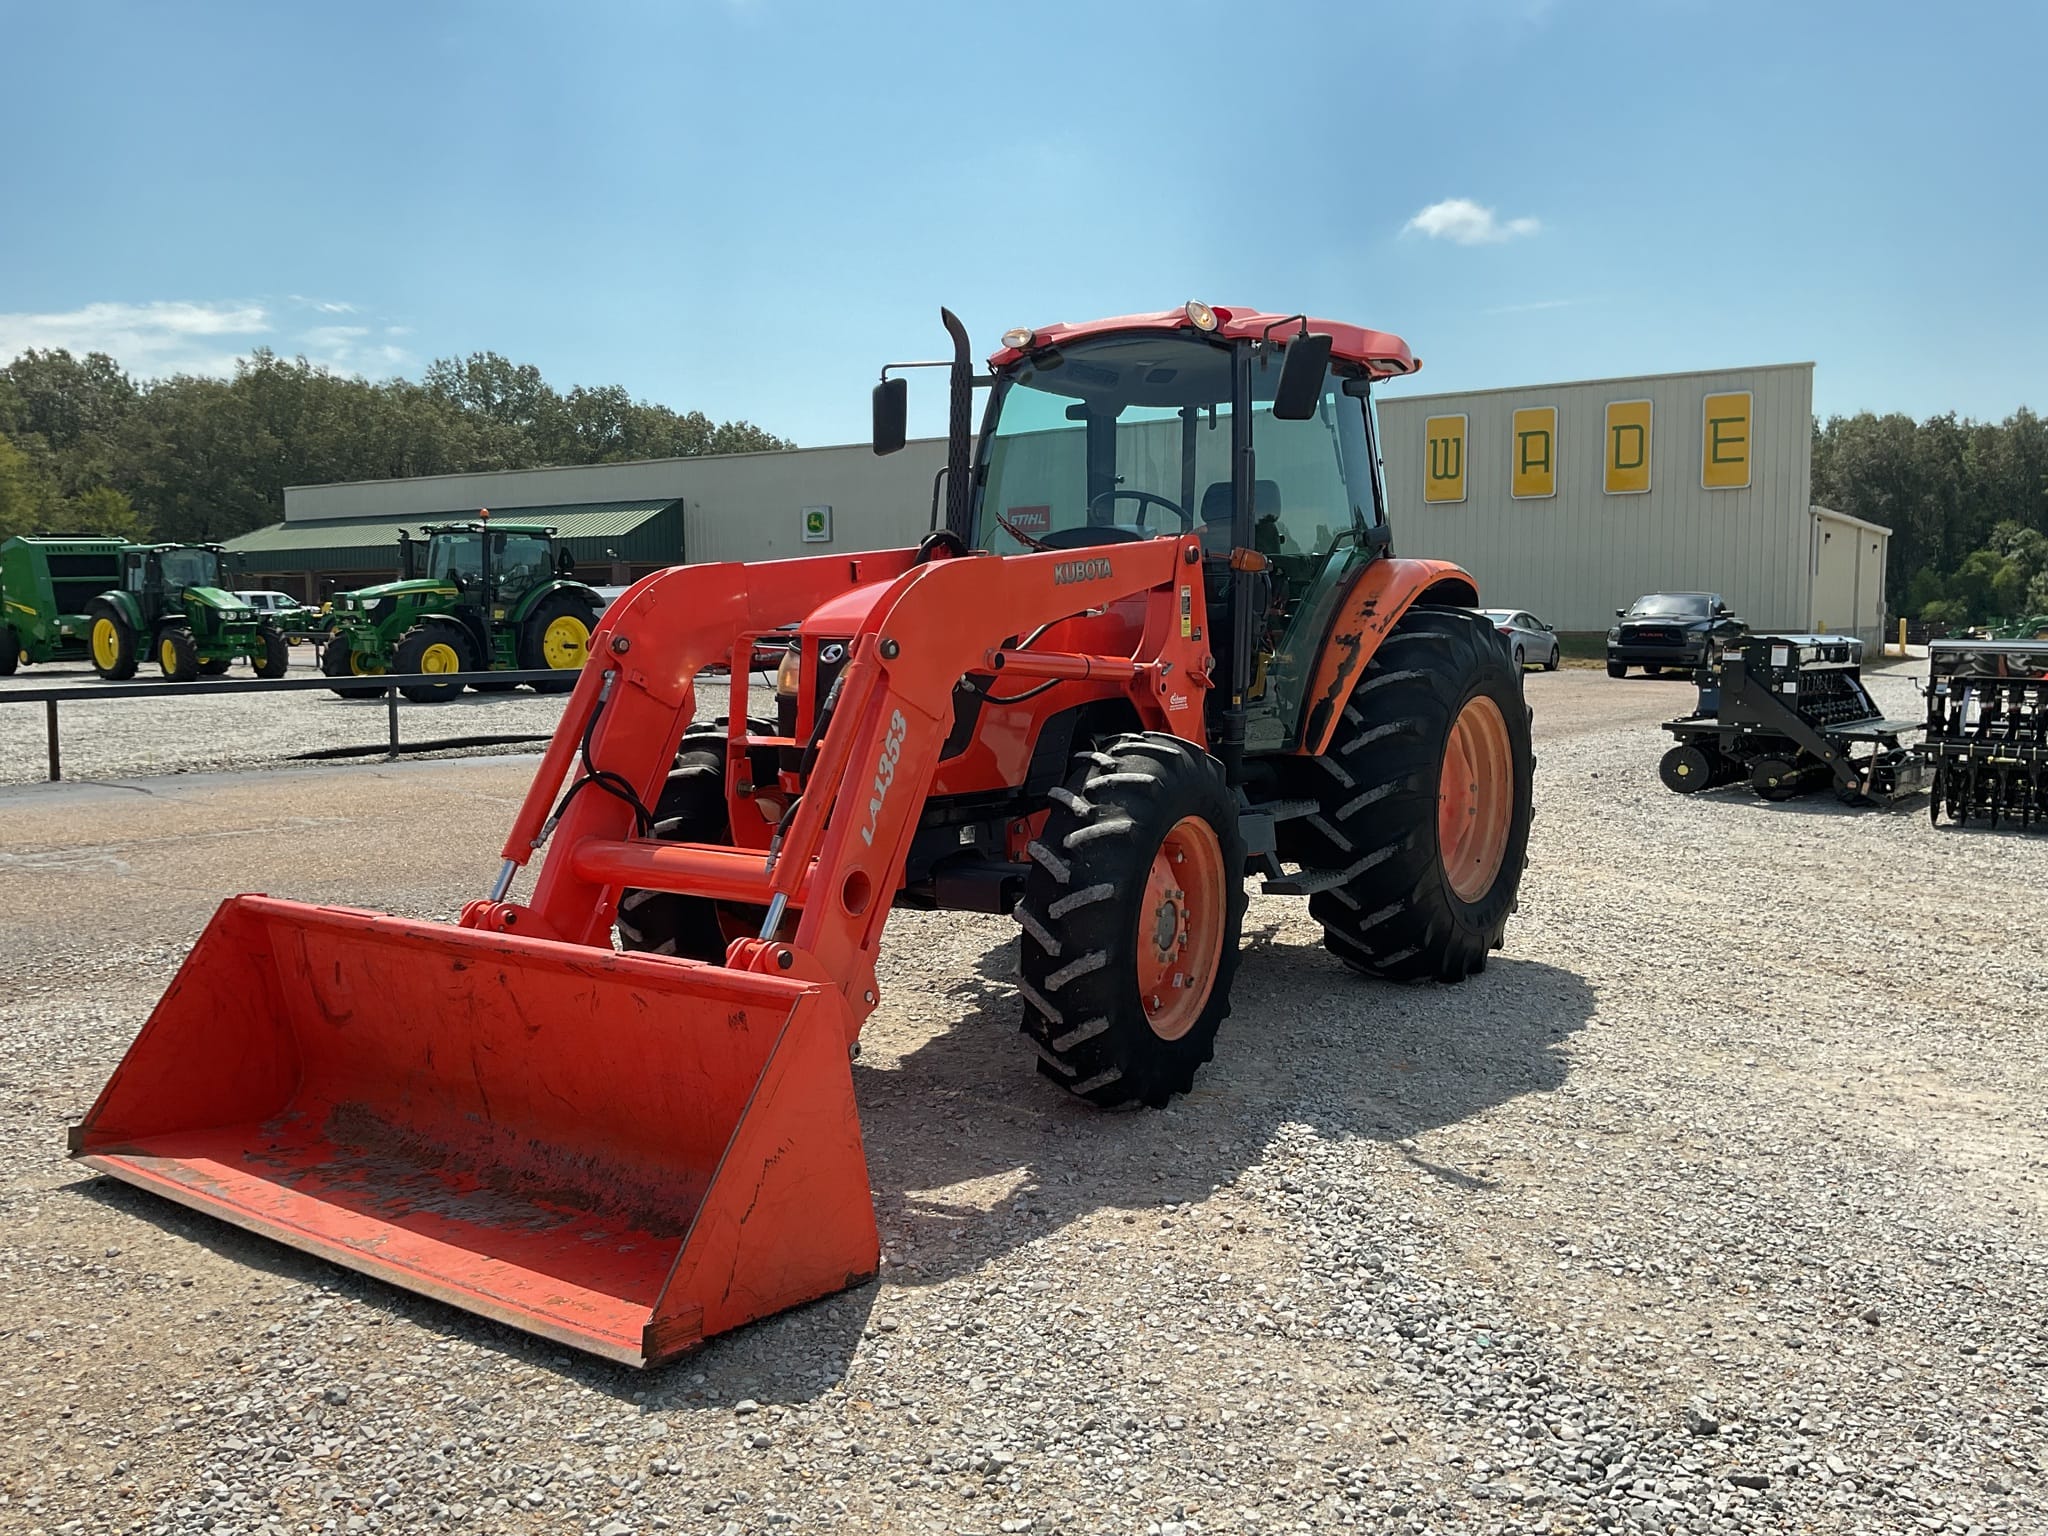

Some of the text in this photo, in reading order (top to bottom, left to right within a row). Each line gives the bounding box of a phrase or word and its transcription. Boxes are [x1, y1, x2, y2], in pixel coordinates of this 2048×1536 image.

[1430, 416, 1745, 480] WADE
[1010, 513, 1046, 526] STIHL
[1054, 557, 1112, 585] KUBOTA
[861, 709, 907, 847] LA1353
